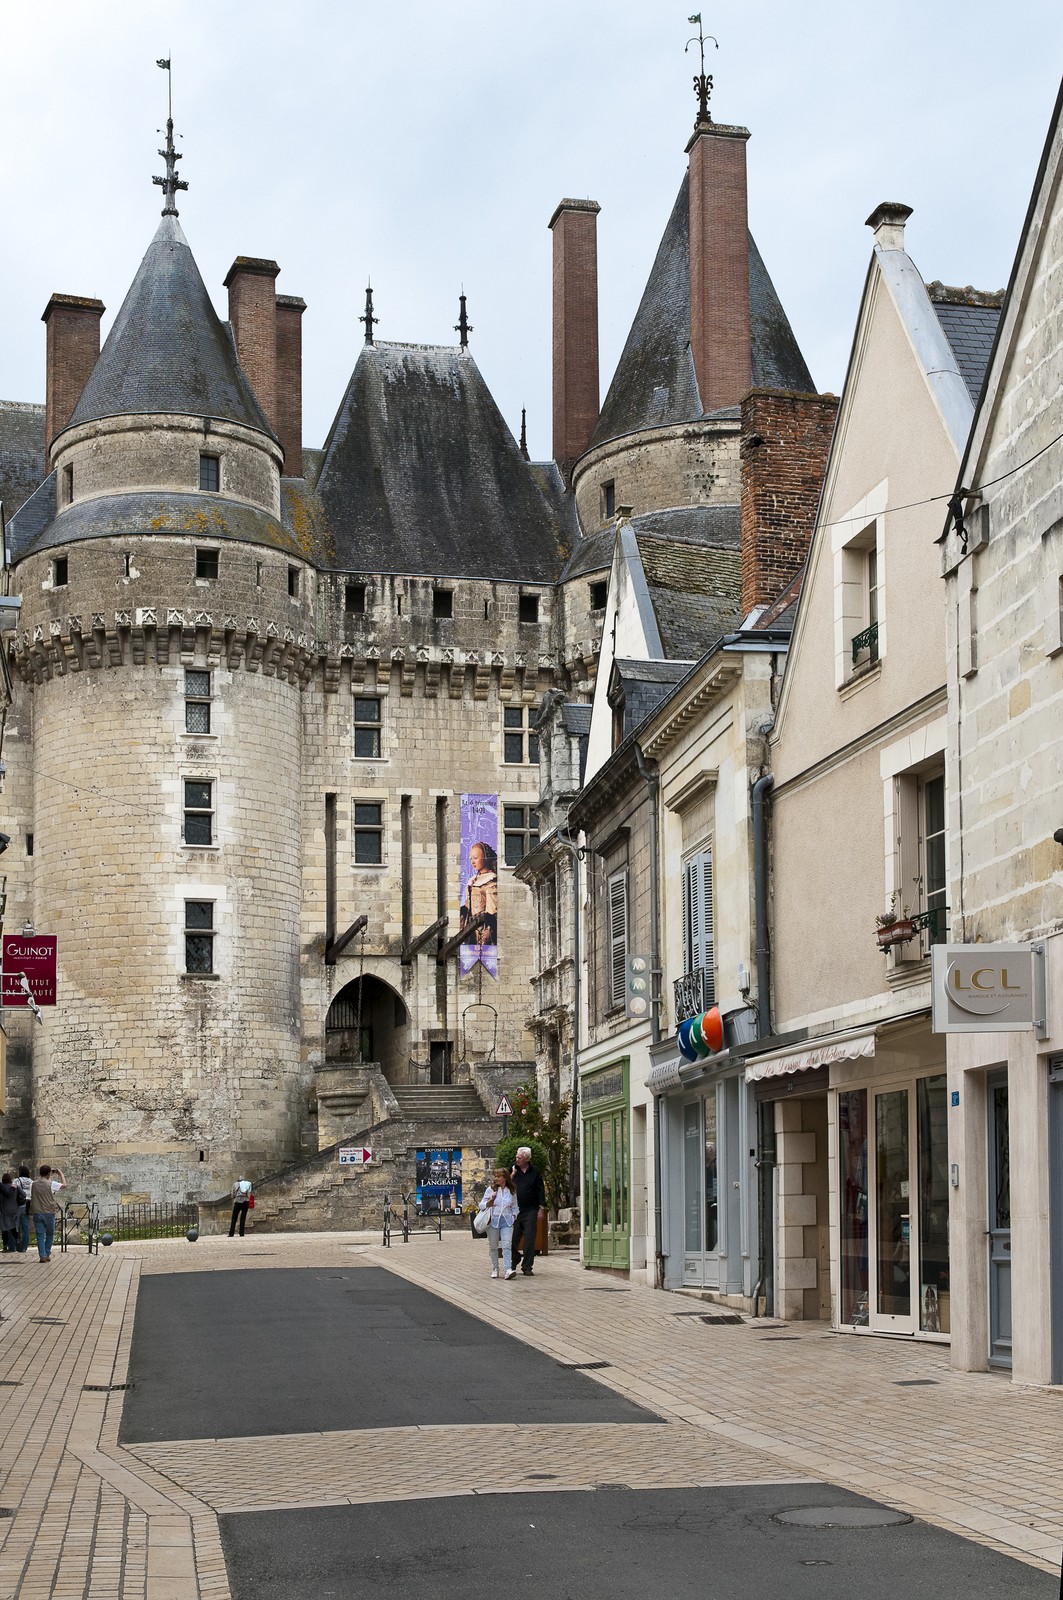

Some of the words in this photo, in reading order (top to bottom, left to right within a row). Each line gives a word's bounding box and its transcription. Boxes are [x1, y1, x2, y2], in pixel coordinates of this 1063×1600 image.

[954, 968, 1021, 991] LCL
[21, 988, 53, 997] BAUTÉ
[420, 1180, 458, 1188] LANGEAIS
